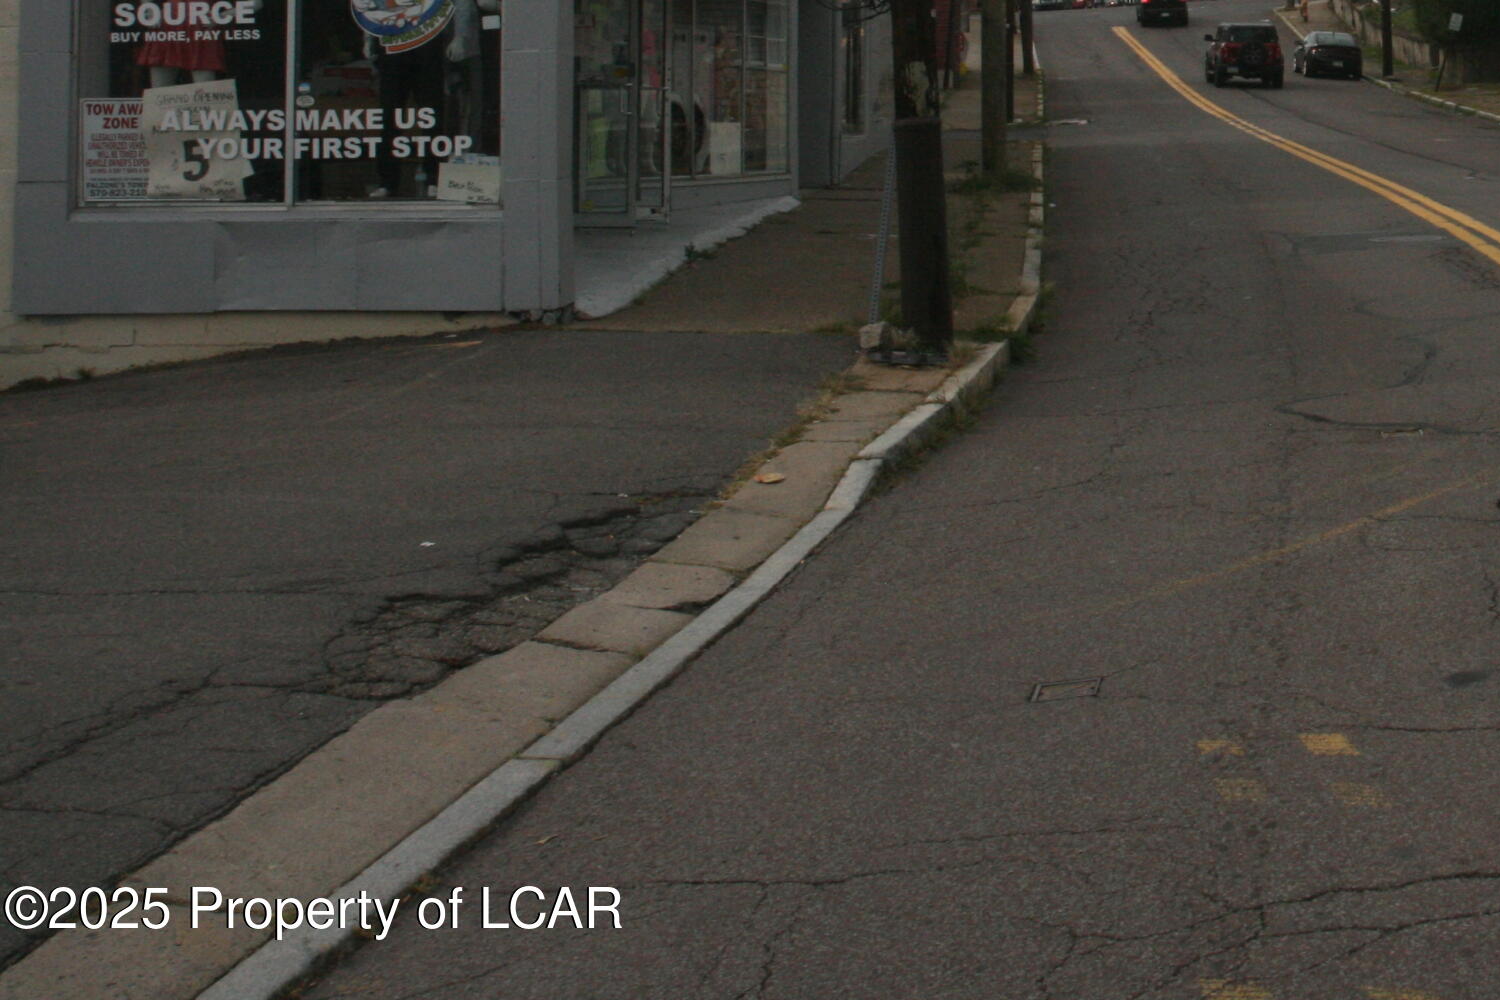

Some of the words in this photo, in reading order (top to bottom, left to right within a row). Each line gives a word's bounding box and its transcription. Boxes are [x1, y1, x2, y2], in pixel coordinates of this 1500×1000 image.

[114, 1, 256, 26] SOURCE
[111, 32, 140, 43] BUY
[145, 31, 190, 43] MORE,
[195, 31, 221, 41] PAY
[225, 29, 260, 40] LESS
[86, 104, 114, 115] TOW
[160, 109, 286, 131] ALWAYS
[296, 108, 384, 131] MAKE
[394, 107, 436, 129] US
[103, 117, 139, 129] ZONE
[198, 137, 284, 159] YOUR
[295, 137, 383, 159] FIRST
[392, 135, 473, 158] STOP
